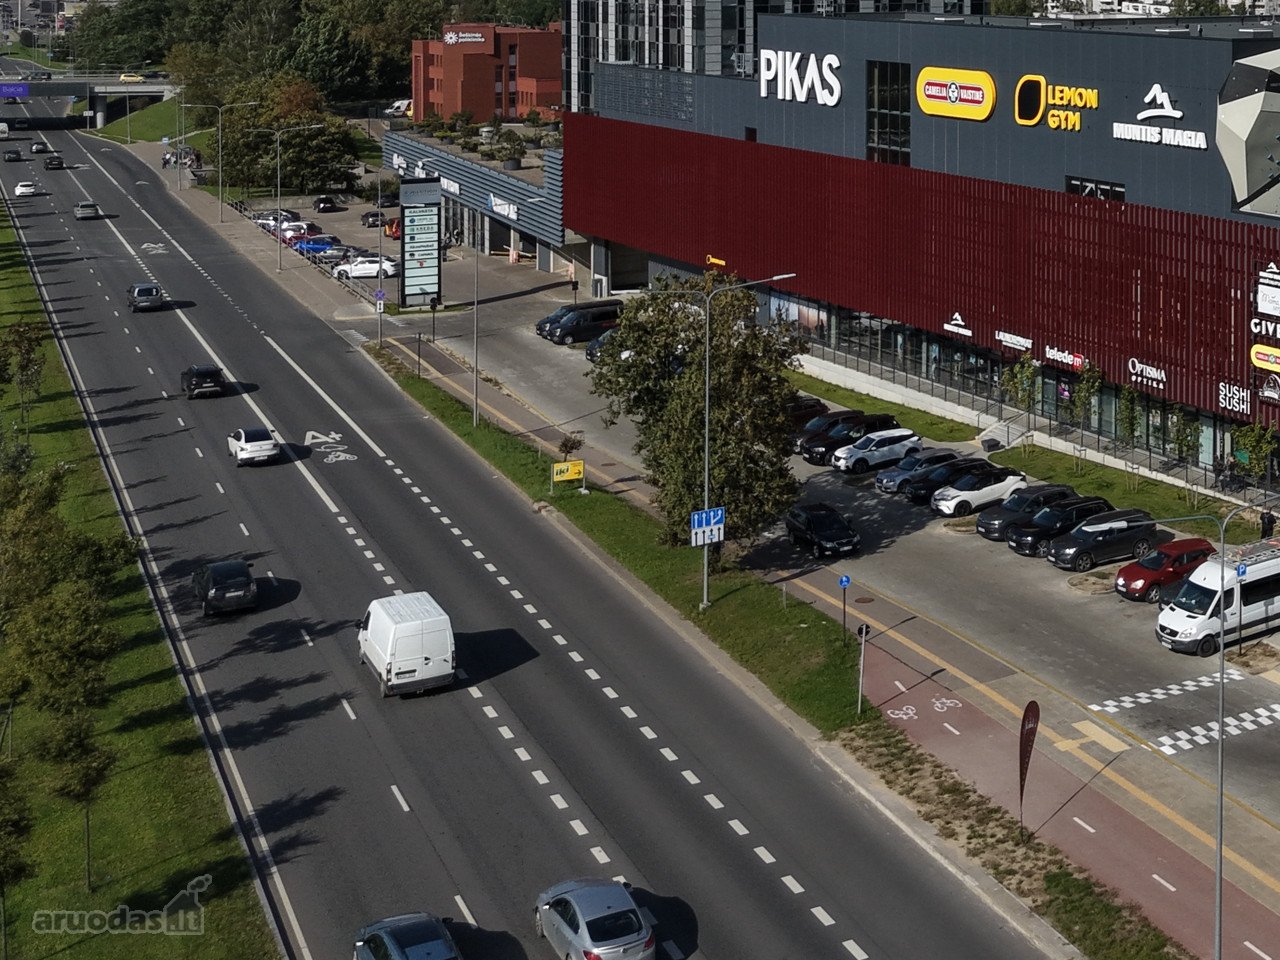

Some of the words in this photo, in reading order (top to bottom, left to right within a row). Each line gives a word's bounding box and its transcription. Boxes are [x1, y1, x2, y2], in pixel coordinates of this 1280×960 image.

[760, 49, 842, 107] PIKAS
[925, 85, 947, 97] CAMELIA
[1047, 84, 1099, 109] LEMON
[1047, 112, 1081, 131] GYM
[1113, 122, 1162, 144] MONTIS
[1162, 128, 1208, 149] MAGIA
[1131, 375, 1164, 390] OPTIKA
[1219, 382, 1250, 402] SUSHI
[1219, 396, 1250, 415] SUSHI
[1239, 564, 1245, 574] P
